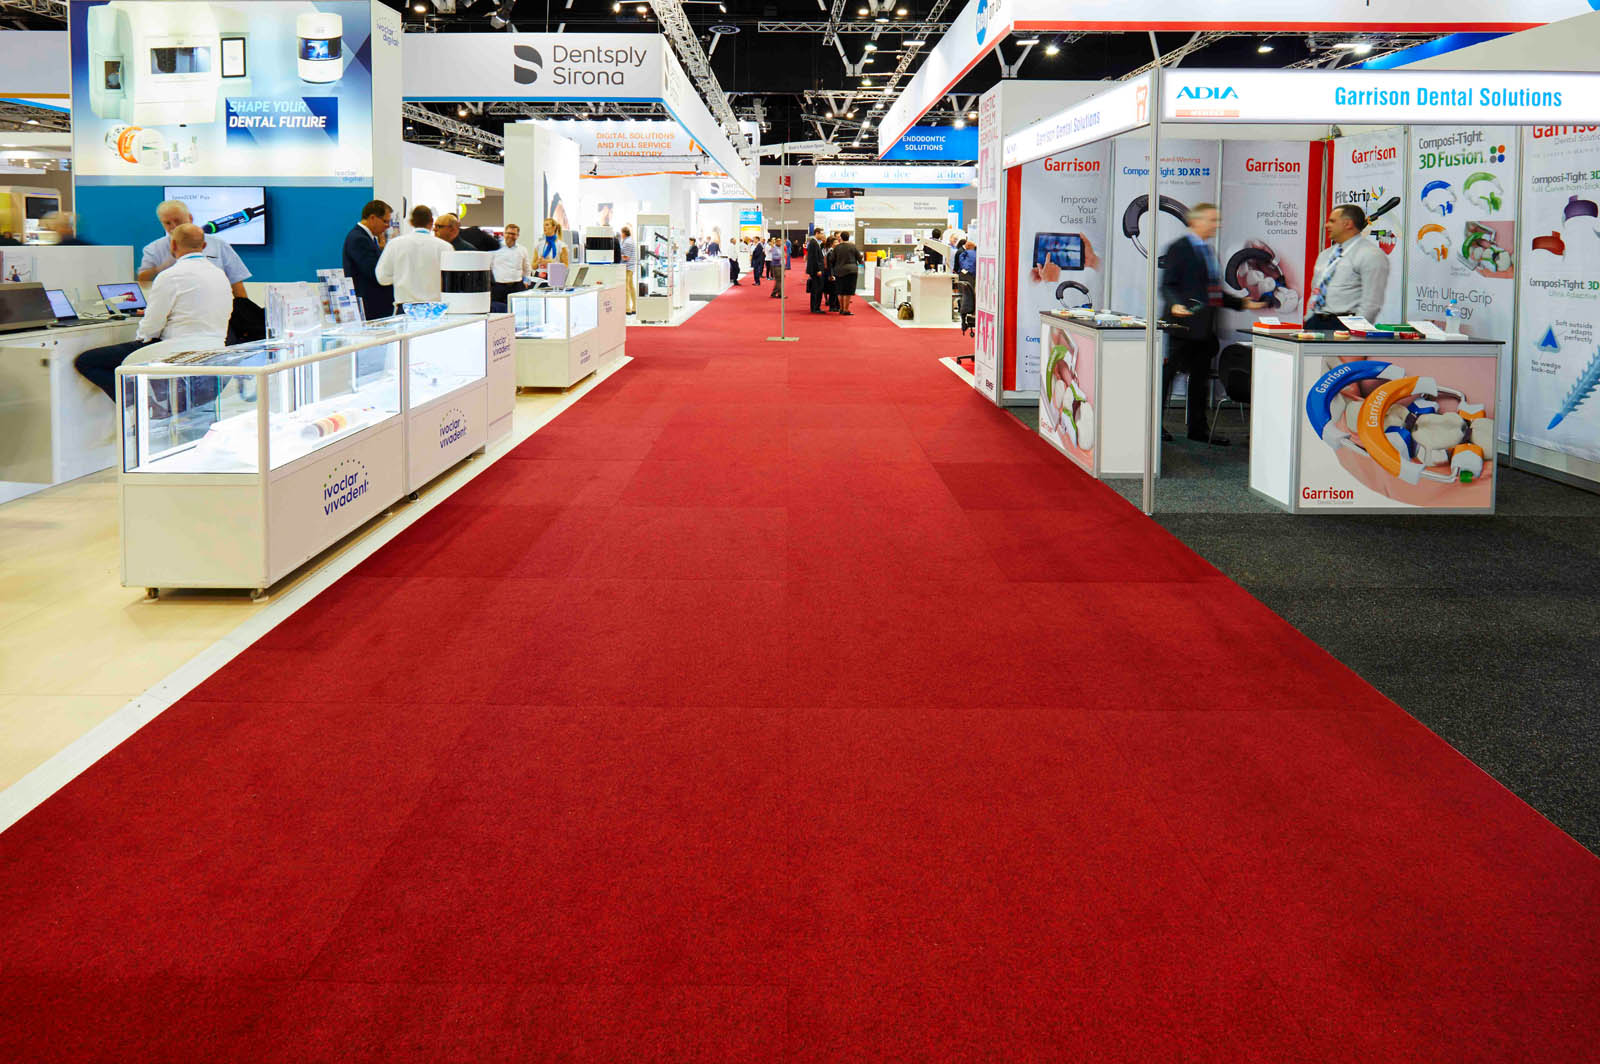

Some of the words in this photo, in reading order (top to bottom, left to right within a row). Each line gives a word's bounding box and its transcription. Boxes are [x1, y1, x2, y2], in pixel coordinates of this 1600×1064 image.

[553, 45, 647, 67] Dentsply
[553, 67, 625, 85] Sirona
[1176, 86, 1239, 99] ADIA
[1335, 86, 1410, 106] Garrison
[1417, 87, 1472, 106] Dental
[1479, 88, 1562, 107] Solutions
[229, 101, 271, 113] SHAPE
[273, 101, 308, 113] YOUR
[229, 116, 277, 128] DENTAL
[279, 116, 327, 128] FUTURE
[596, 132, 627, 140] DIGITAL
[629, 132, 676, 140] SOLUTIONS
[902, 135, 947, 143] ENDODONTIC
[1533, 125, 1598, 139] Garriso
[597, 141, 615, 149] AND
[616, 141, 636, 149] FULL
[638, 141, 673, 149] SERVICE
[1418, 131, 1484, 150] Composi-Tight
[905, 144, 944, 152] SOLUTIONS
[1352, 145, 1397, 164] Garrison
[1044, 157, 1100, 173] Garrison
[1246, 157, 1300, 173] Garrison
[1418, 153, 1437, 170] 3D
[1438, 148, 1484, 168] Fusion
[1177, 167, 1188, 176] 3D
[1189, 167, 1201, 176] XR
[1531, 171, 1587, 184] Composi-Tight
[1061, 195, 1098, 206] Improve
[1077, 205, 1097, 214] Your
[1256, 210, 1298, 220] predictable
[1060, 215, 1084, 224] Class
[1529, 278, 1585, 291] Composi-Tight
[1416, 286, 1439, 299] With
[1441, 287, 1493, 307] Ultra-Grip
[1416, 299, 1474, 320] Techngy
[1564, 335, 1592, 344] perfectly
[1315, 365, 1352, 394] Garrison
[1367, 390, 1389, 428] Garrison
[440, 418, 460, 437] ivoclar
[440, 425, 466, 449] vivadent
[324, 472, 358, 501] ivoclar
[1302, 486, 1354, 500] Garrison
[324, 480, 369, 516] vivadent
